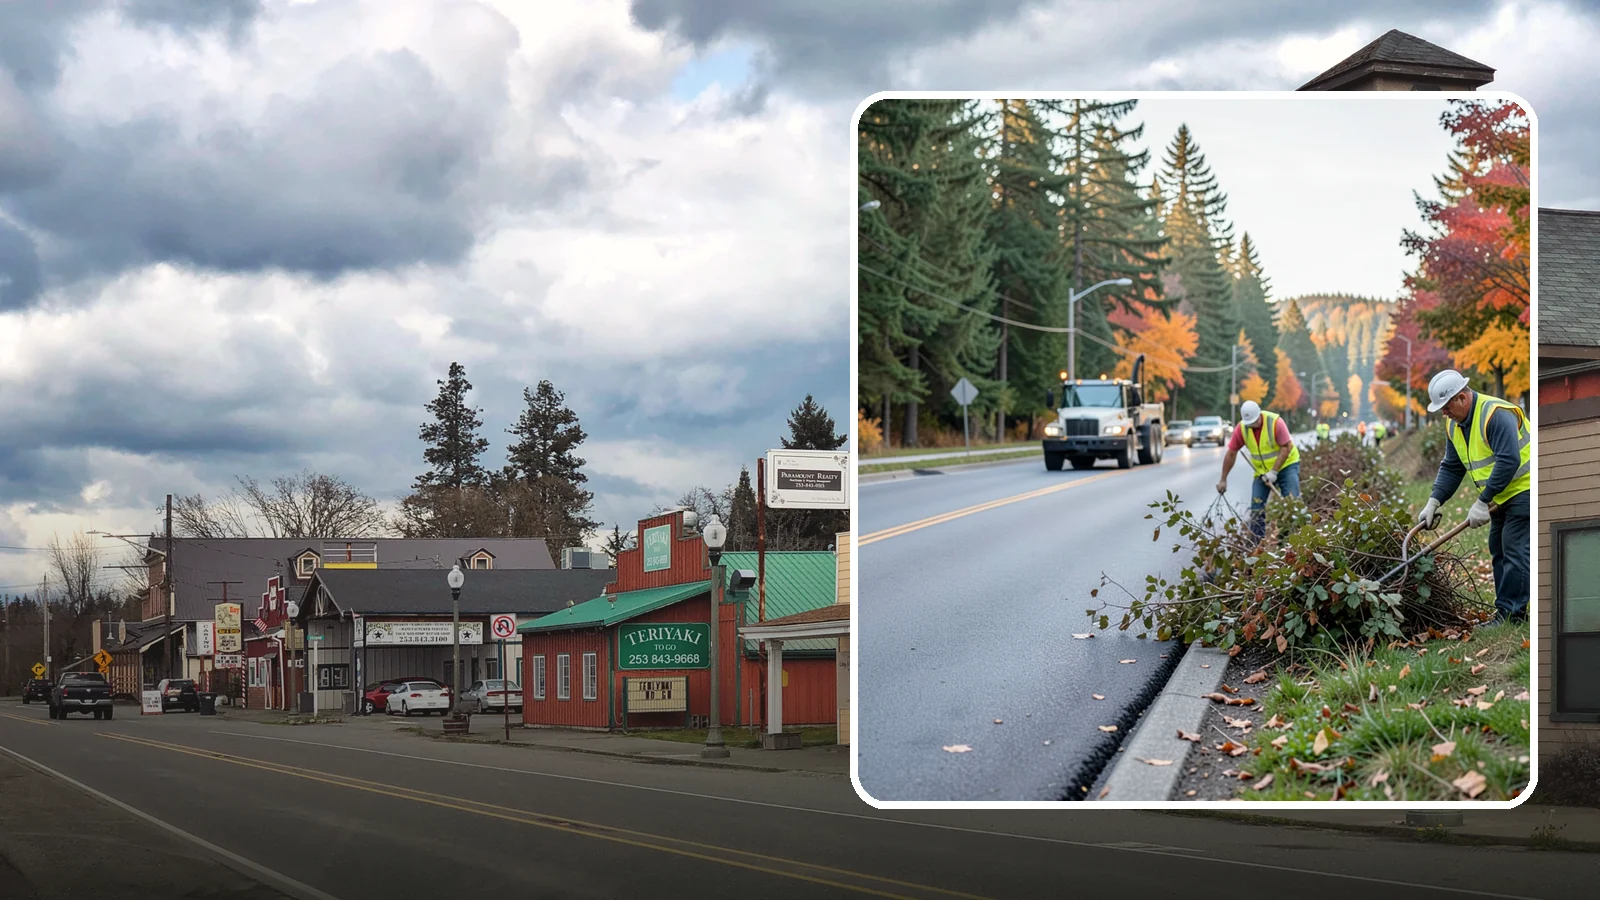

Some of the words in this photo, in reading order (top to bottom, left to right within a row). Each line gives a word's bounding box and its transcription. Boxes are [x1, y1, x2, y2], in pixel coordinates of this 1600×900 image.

[625, 628, 702, 646] TERIYAKI
[629, 654, 648, 664] 253
[652, 654, 700, 664] 843-9668
[639, 682, 672, 690] TERIYAKI
